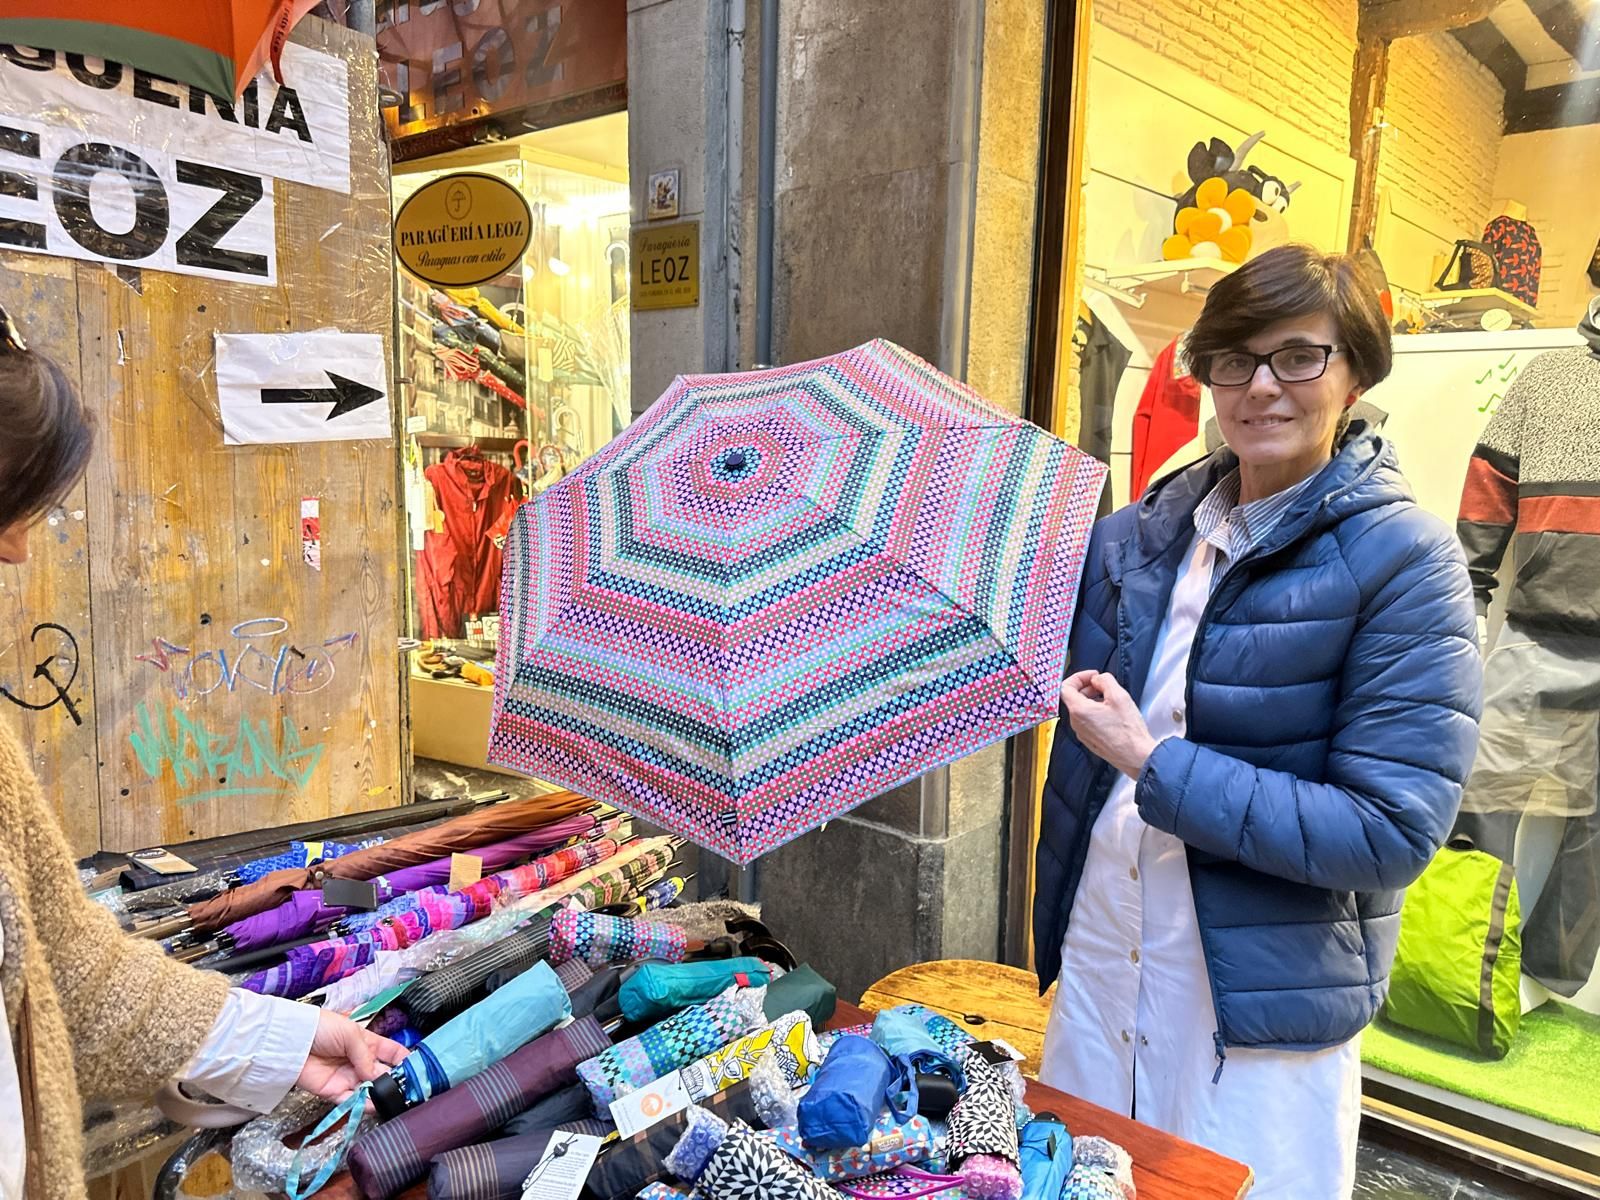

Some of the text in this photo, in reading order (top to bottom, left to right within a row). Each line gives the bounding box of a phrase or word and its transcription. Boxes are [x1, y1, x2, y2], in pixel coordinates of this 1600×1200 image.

[400, 220, 523, 247] PARAGÜERÍA LEOZ
[415, 247, 506, 270] Paraguas con estilo
[640, 255, 690, 285] LEOZ
